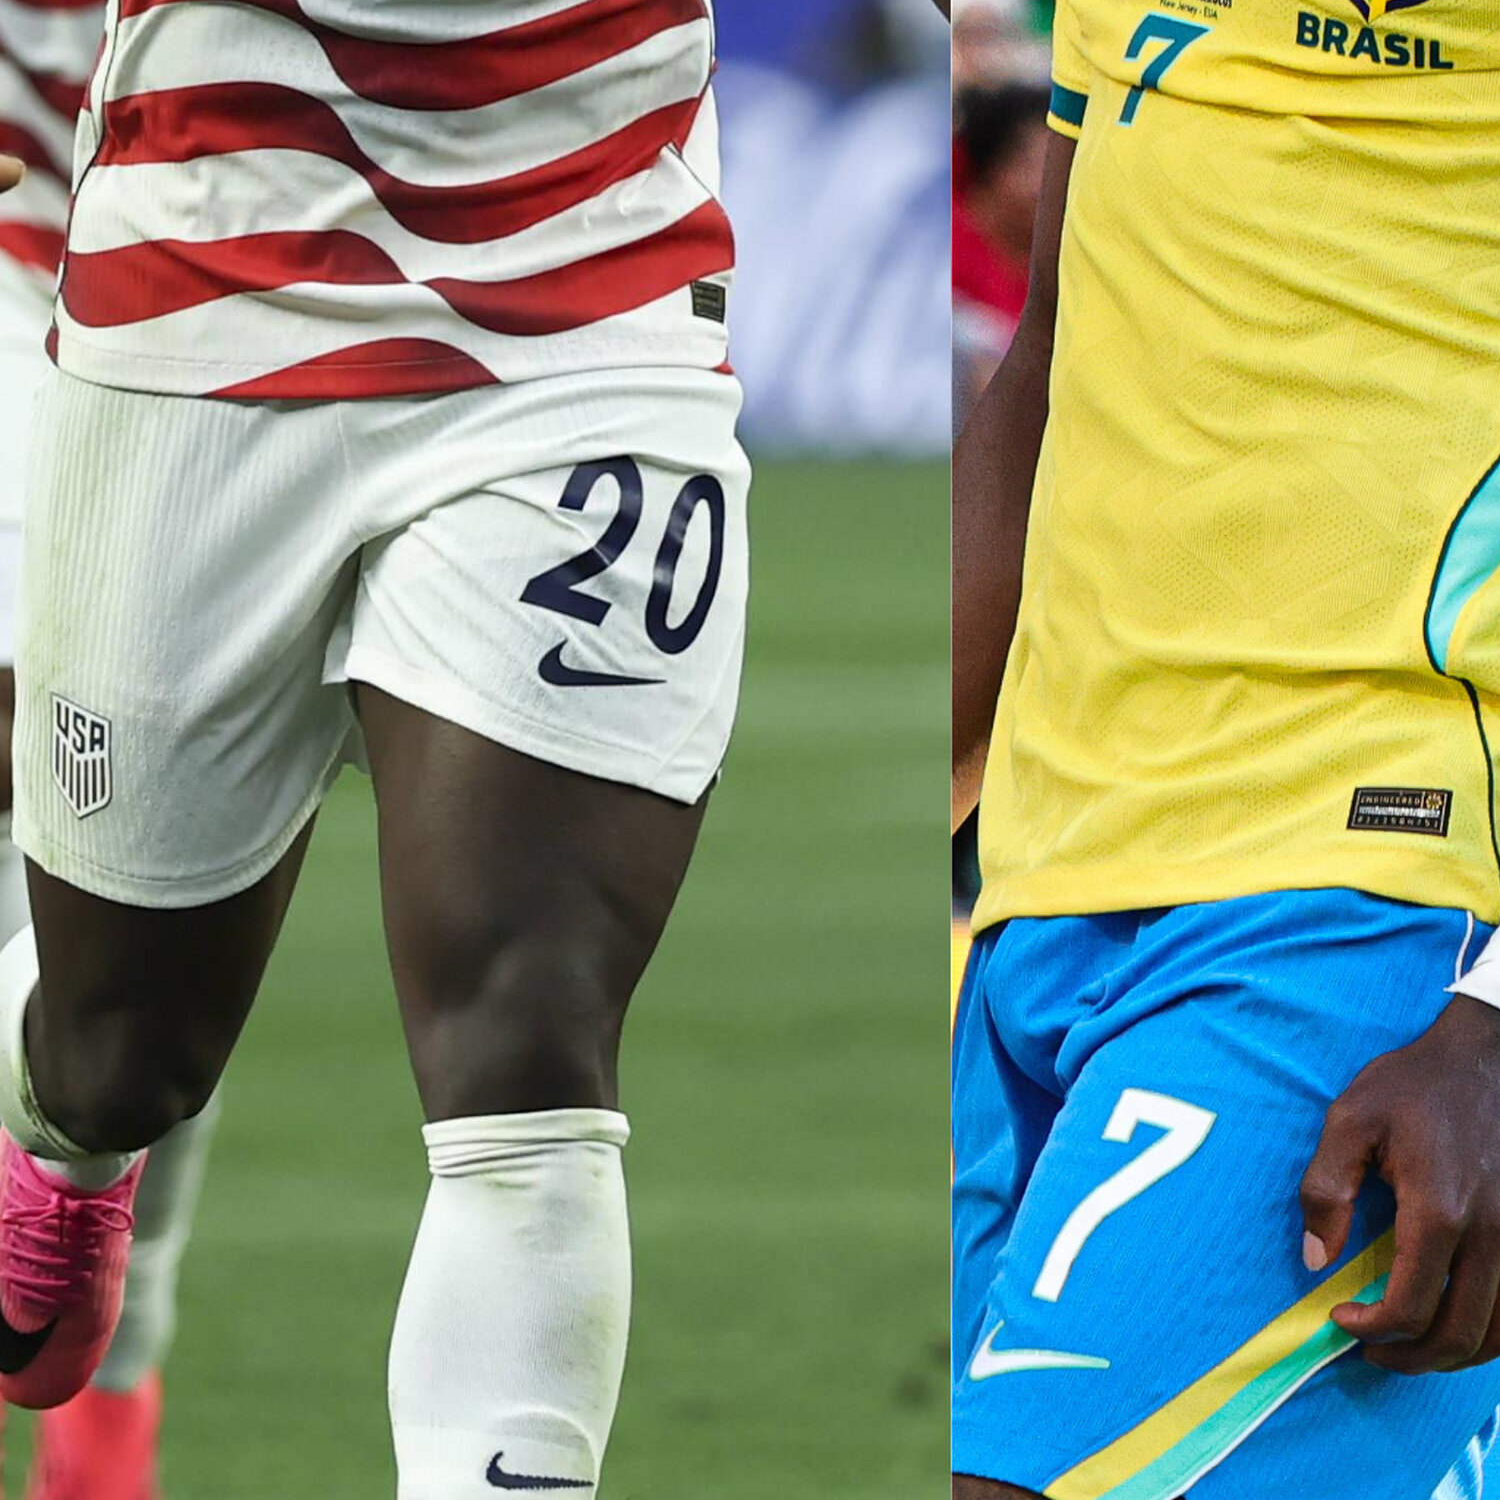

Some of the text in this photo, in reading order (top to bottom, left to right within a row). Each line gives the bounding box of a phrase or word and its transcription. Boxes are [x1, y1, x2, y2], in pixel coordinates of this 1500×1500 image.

[1117, 11, 1214, 127] 7
[1295, 10, 1454, 70] BRASIL
[518, 454, 725, 655] 20
[56, 701, 105, 754] USA
[1031, 1087, 1218, 1303] 7
